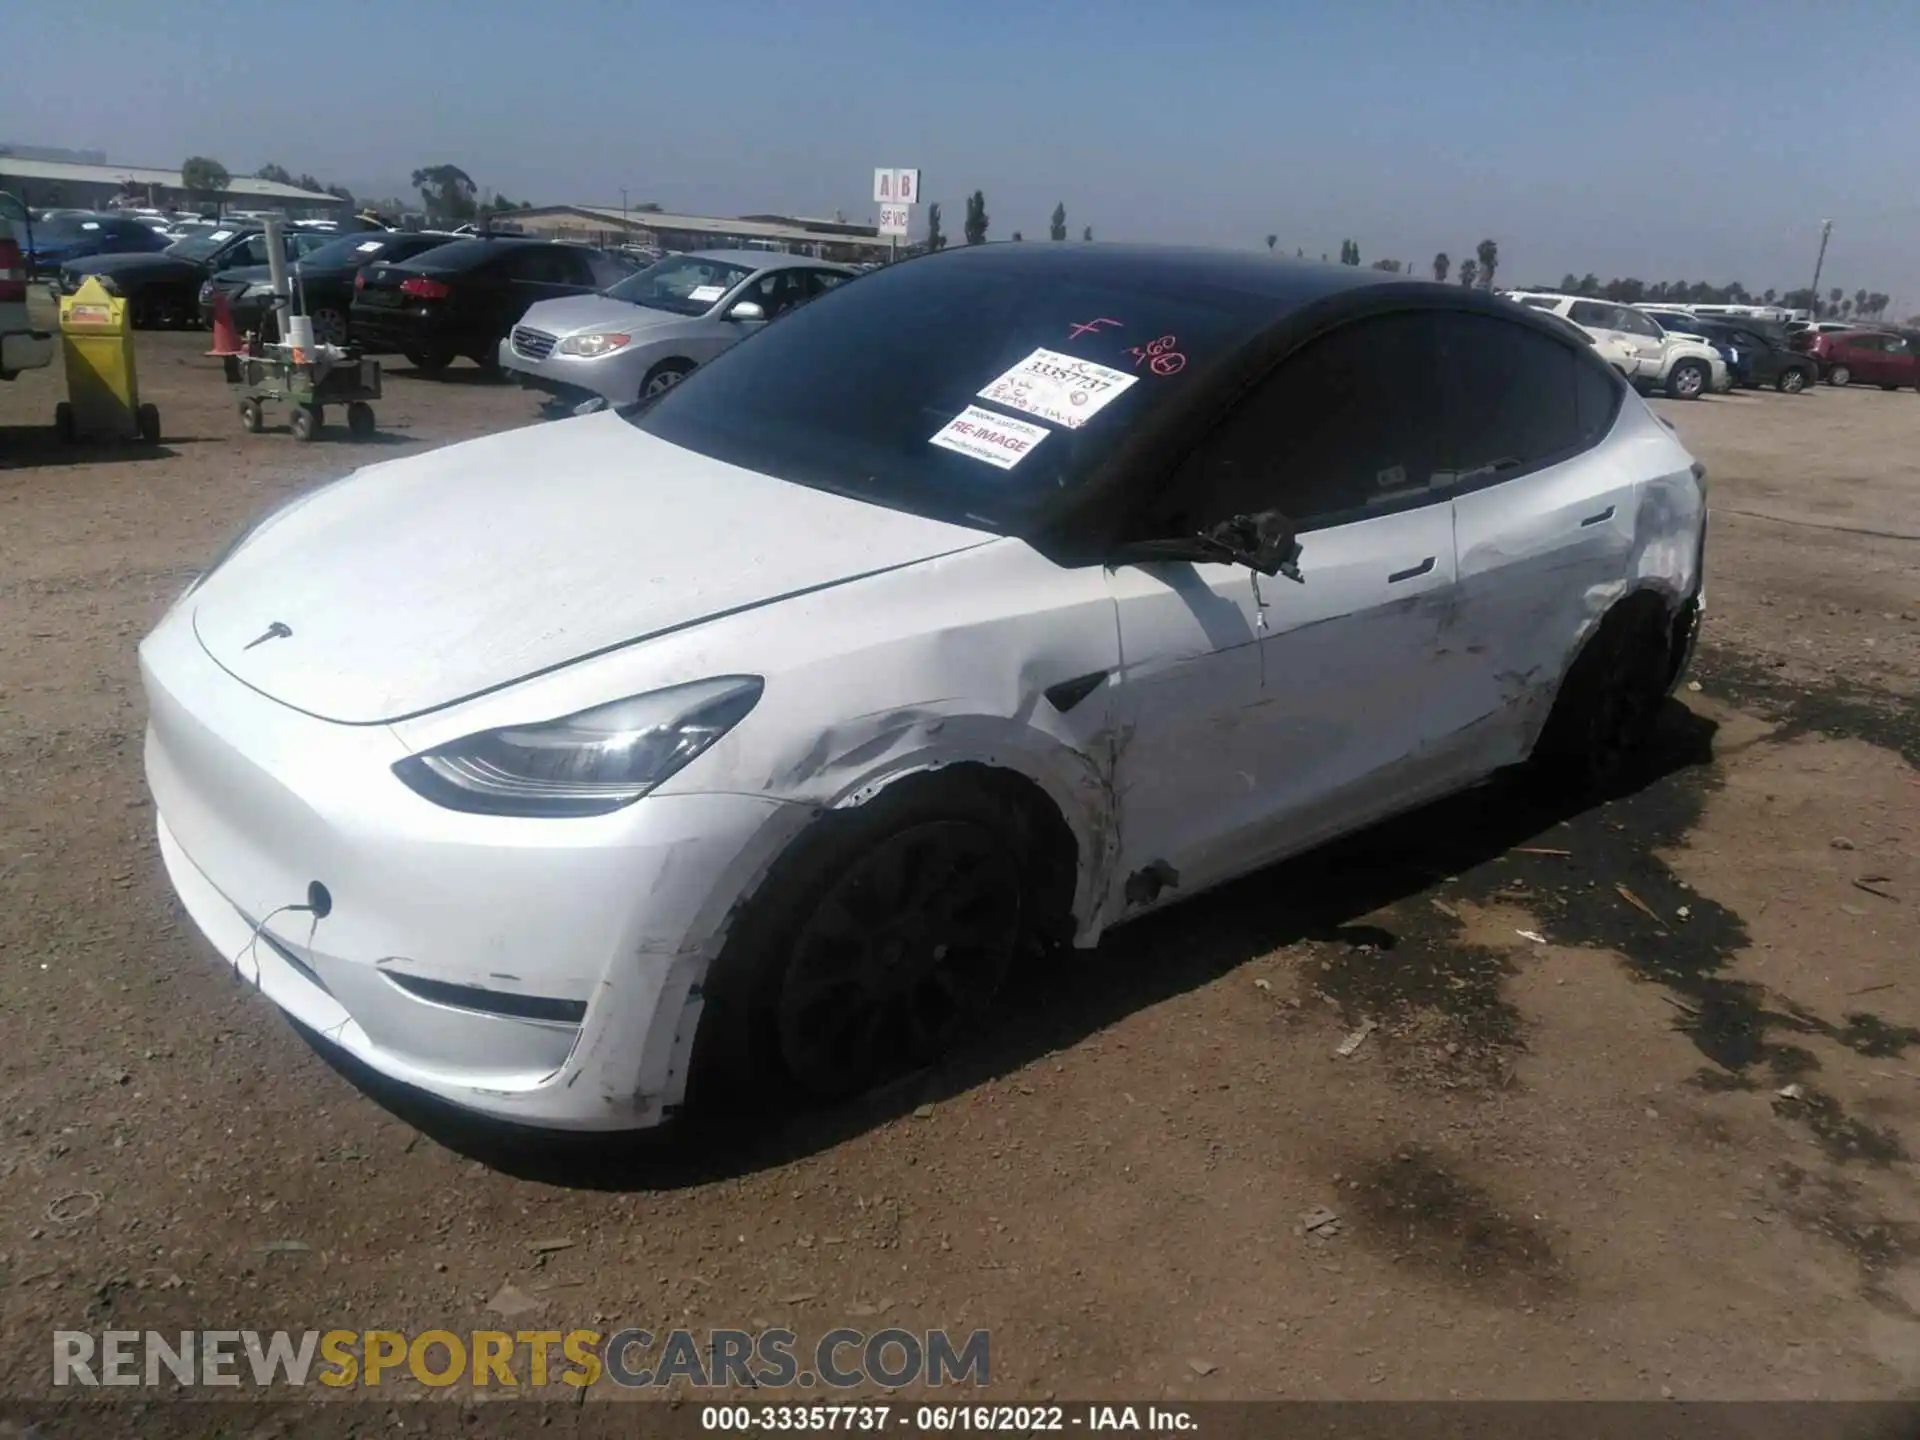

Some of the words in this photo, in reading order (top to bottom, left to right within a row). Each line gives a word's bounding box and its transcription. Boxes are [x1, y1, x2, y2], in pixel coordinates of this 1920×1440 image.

[880, 174, 889, 196] A
[901, 175, 910, 197] B
[1025, 361, 1111, 393] 33357737
[950, 420, 1032, 452] RE-IMAGE
